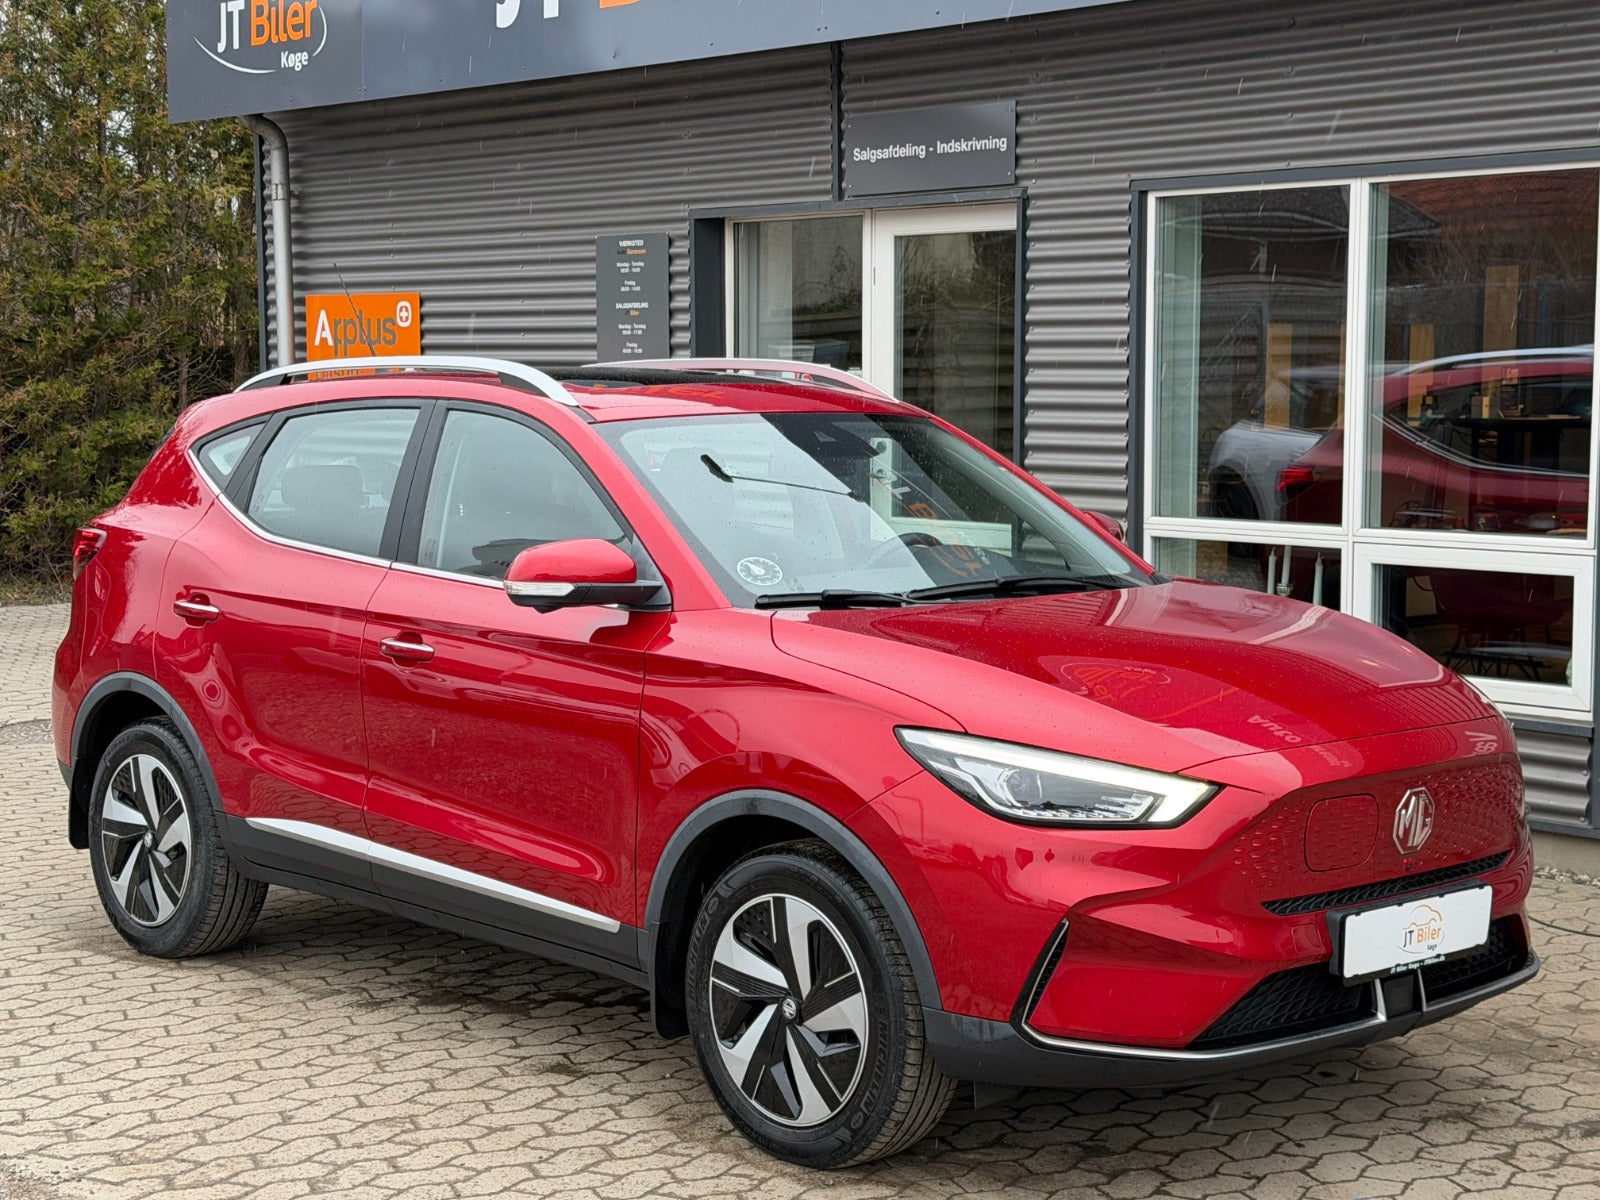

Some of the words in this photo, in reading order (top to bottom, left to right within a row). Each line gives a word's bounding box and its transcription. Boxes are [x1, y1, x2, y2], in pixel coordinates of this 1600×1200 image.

[217, 0, 245, 53] JT
[250, 0, 318, 46] Biler
[280, 51, 309, 71] Køge
[852, 143, 926, 163] Salgsafdeling
[936, 135, 1008, 154] Indskrivning
[1396, 790, 1434, 851] MG
[1402, 930, 1415, 948] JT
[1417, 925, 1442, 944] Biler
